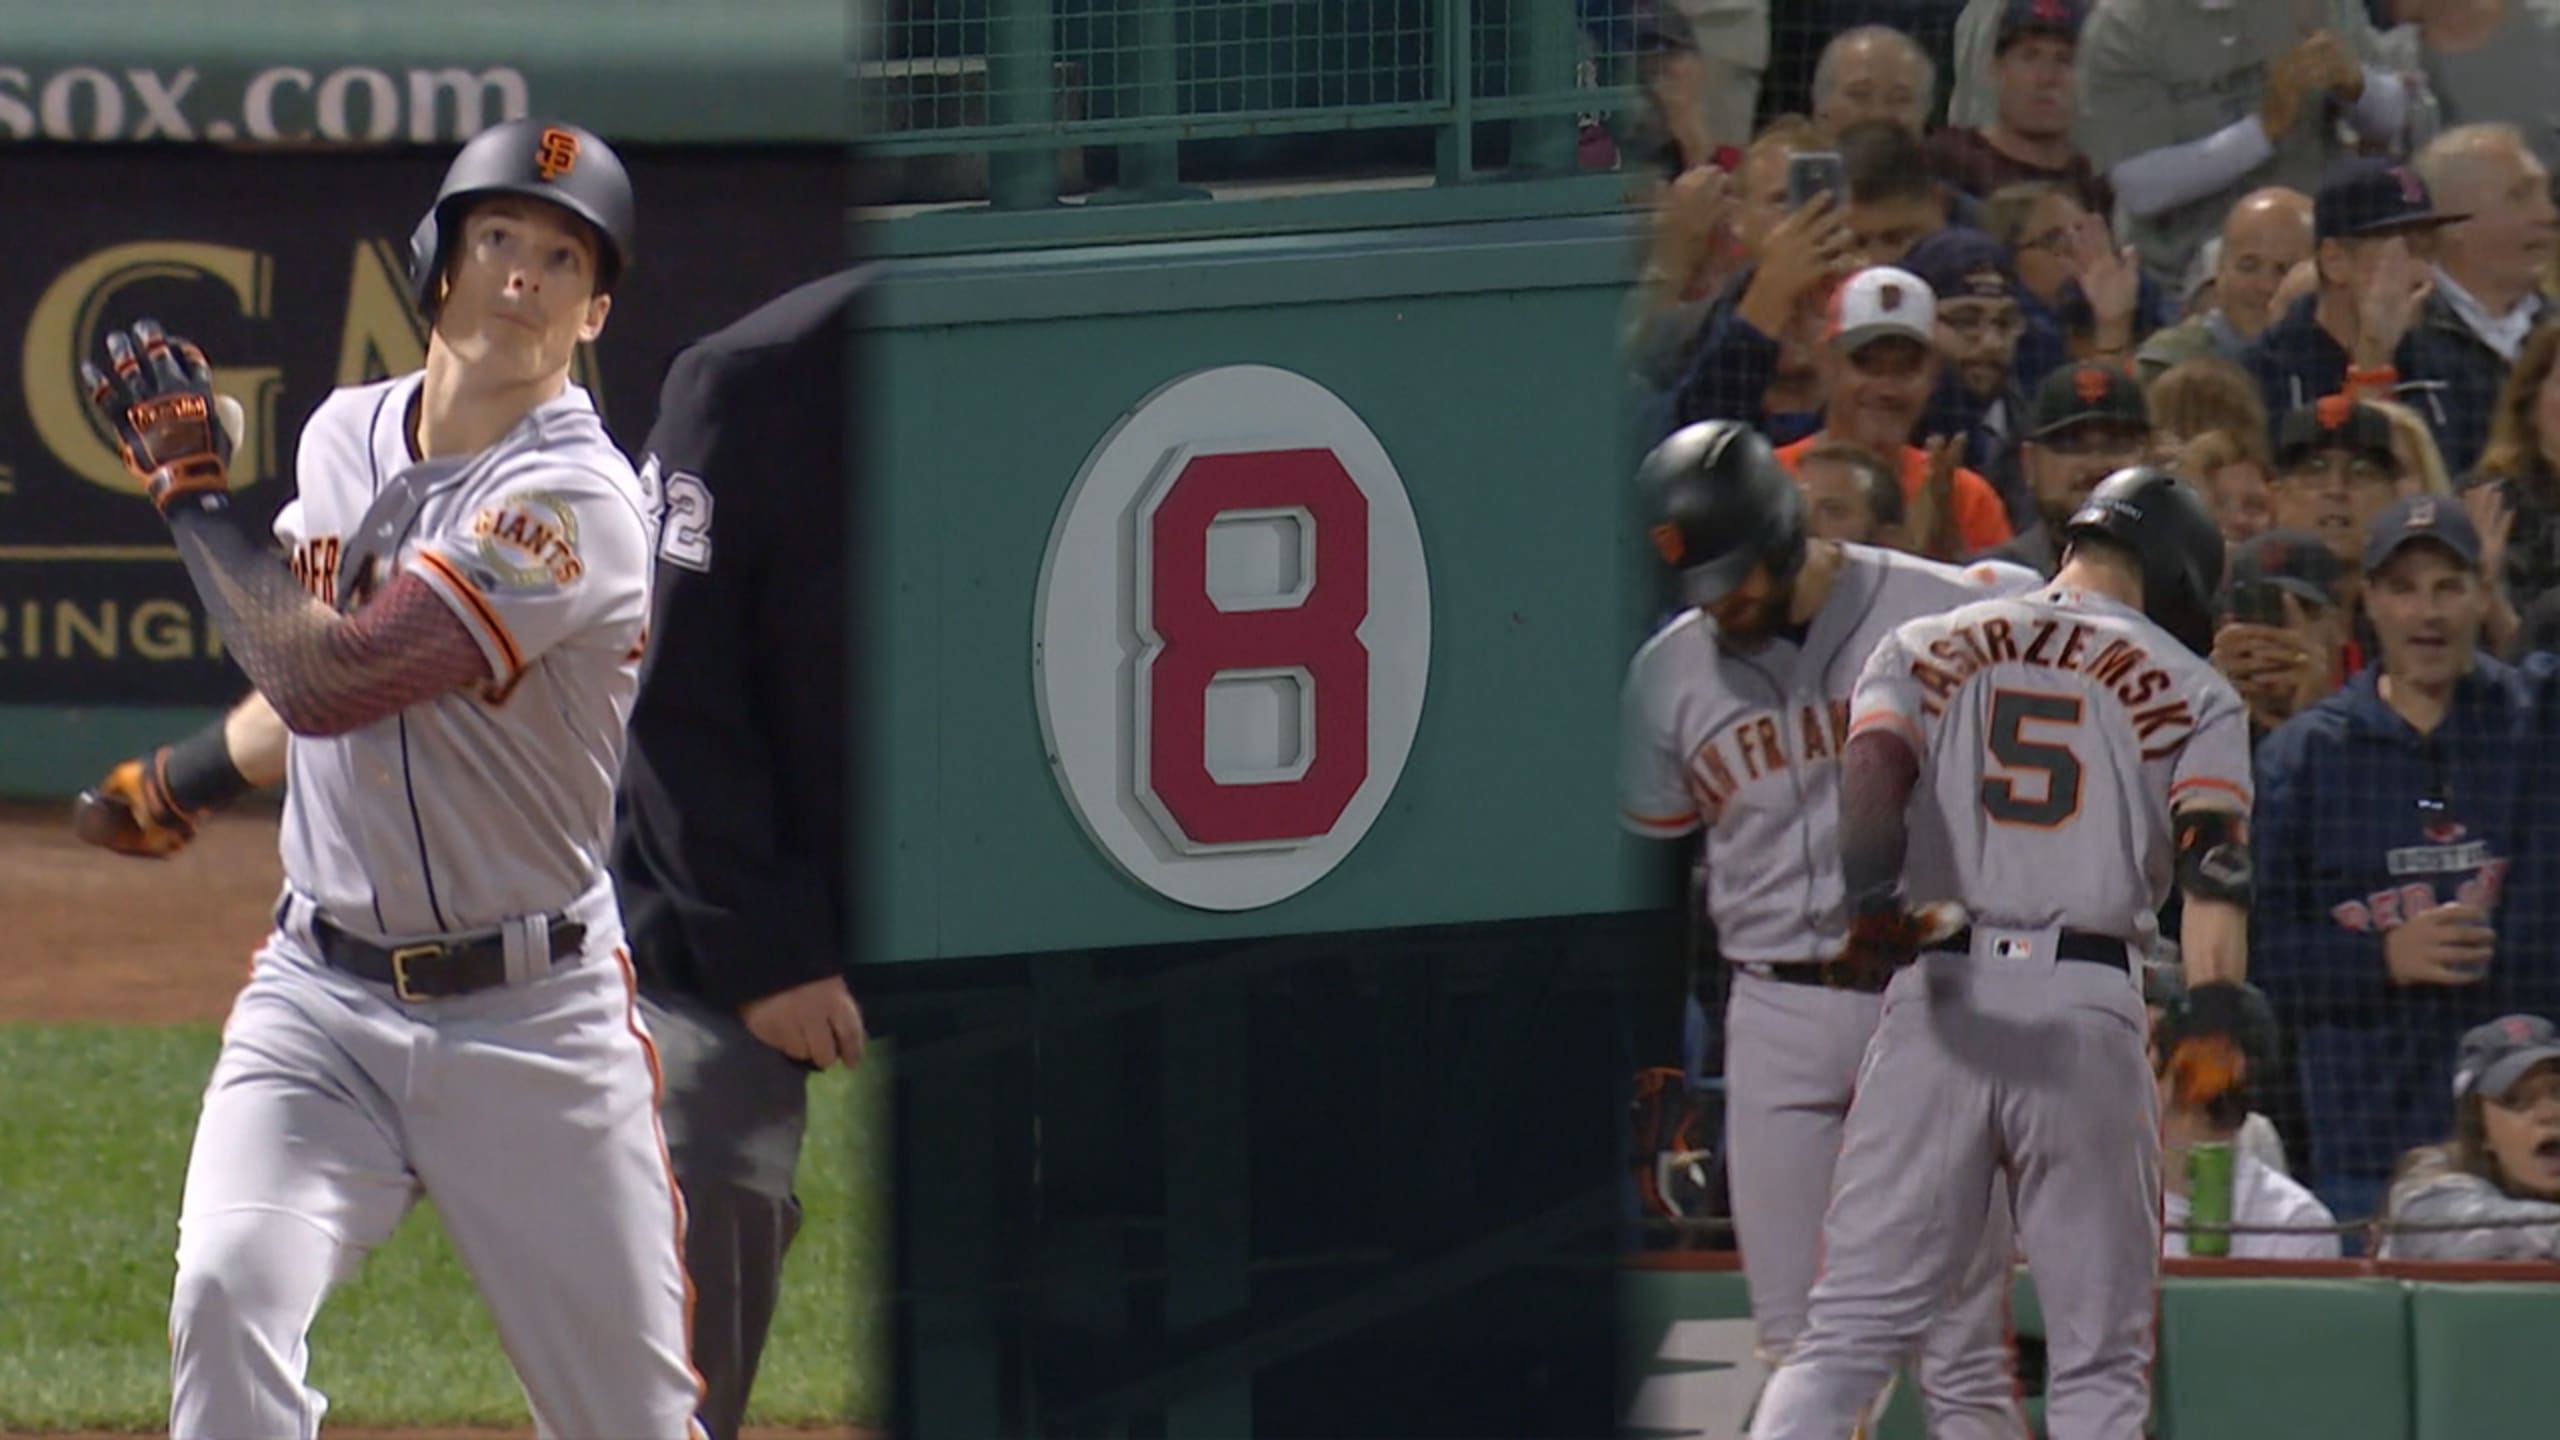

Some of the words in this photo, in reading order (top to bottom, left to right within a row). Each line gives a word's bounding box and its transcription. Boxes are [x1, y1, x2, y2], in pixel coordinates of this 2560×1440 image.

[474, 508, 584, 588] GIANTS
[1136, 445, 1370, 854] 8
[1980, 686, 2086, 831] 5
